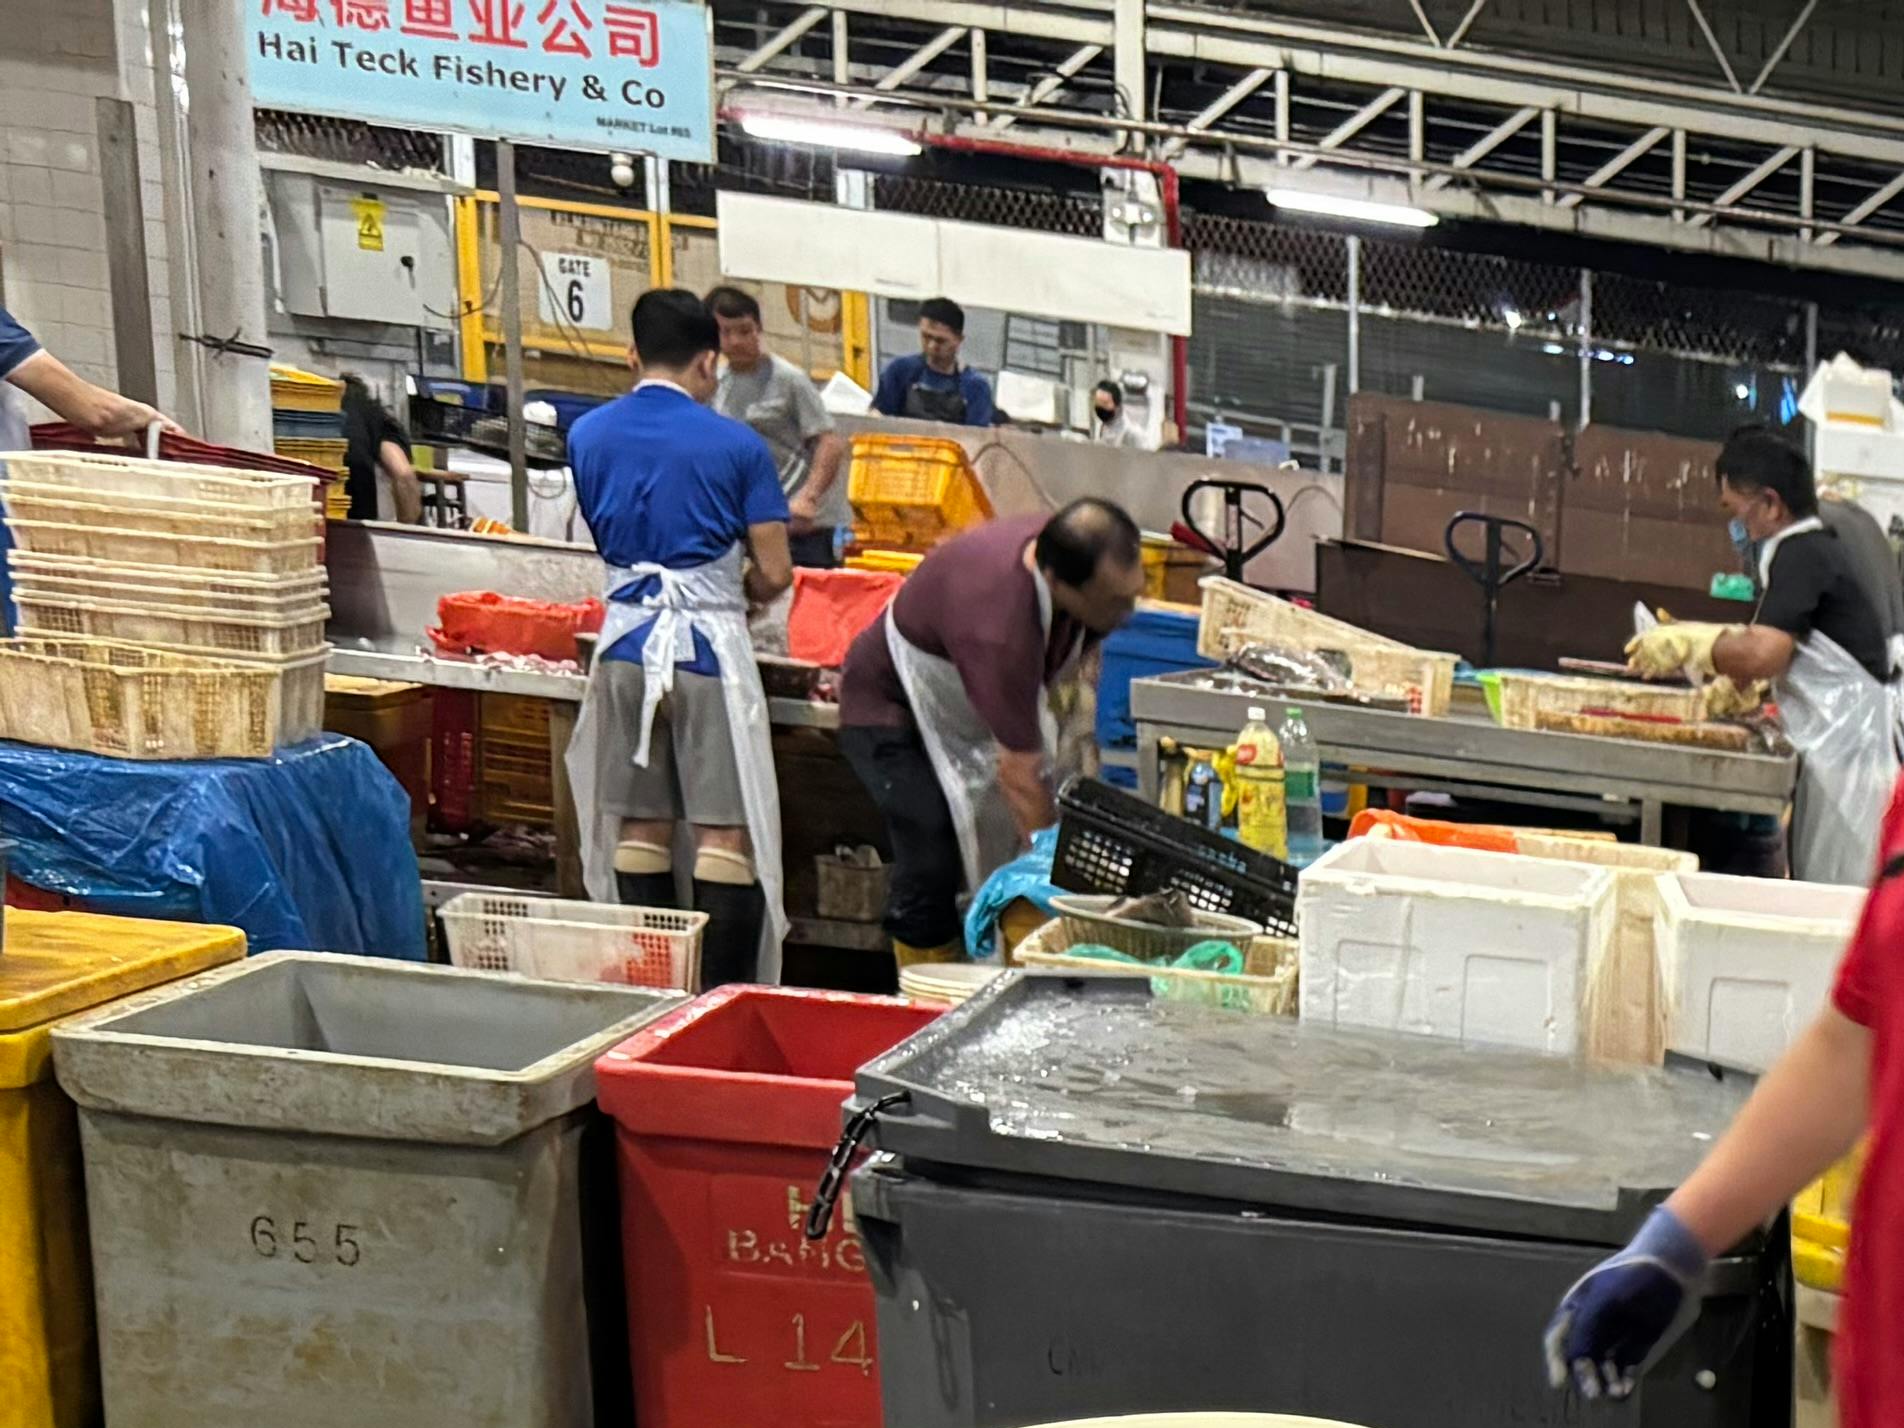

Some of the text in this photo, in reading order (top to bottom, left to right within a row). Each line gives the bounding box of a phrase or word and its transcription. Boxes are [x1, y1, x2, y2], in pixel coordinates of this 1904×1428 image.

[258, 31, 666, 109] Hai Teck Fishery & Co
[558, 257, 591, 278] GATE
[566, 278, 585, 323] 6
[249, 1214, 362, 1268] 655
[705, 1303, 874, 1377] L 14
